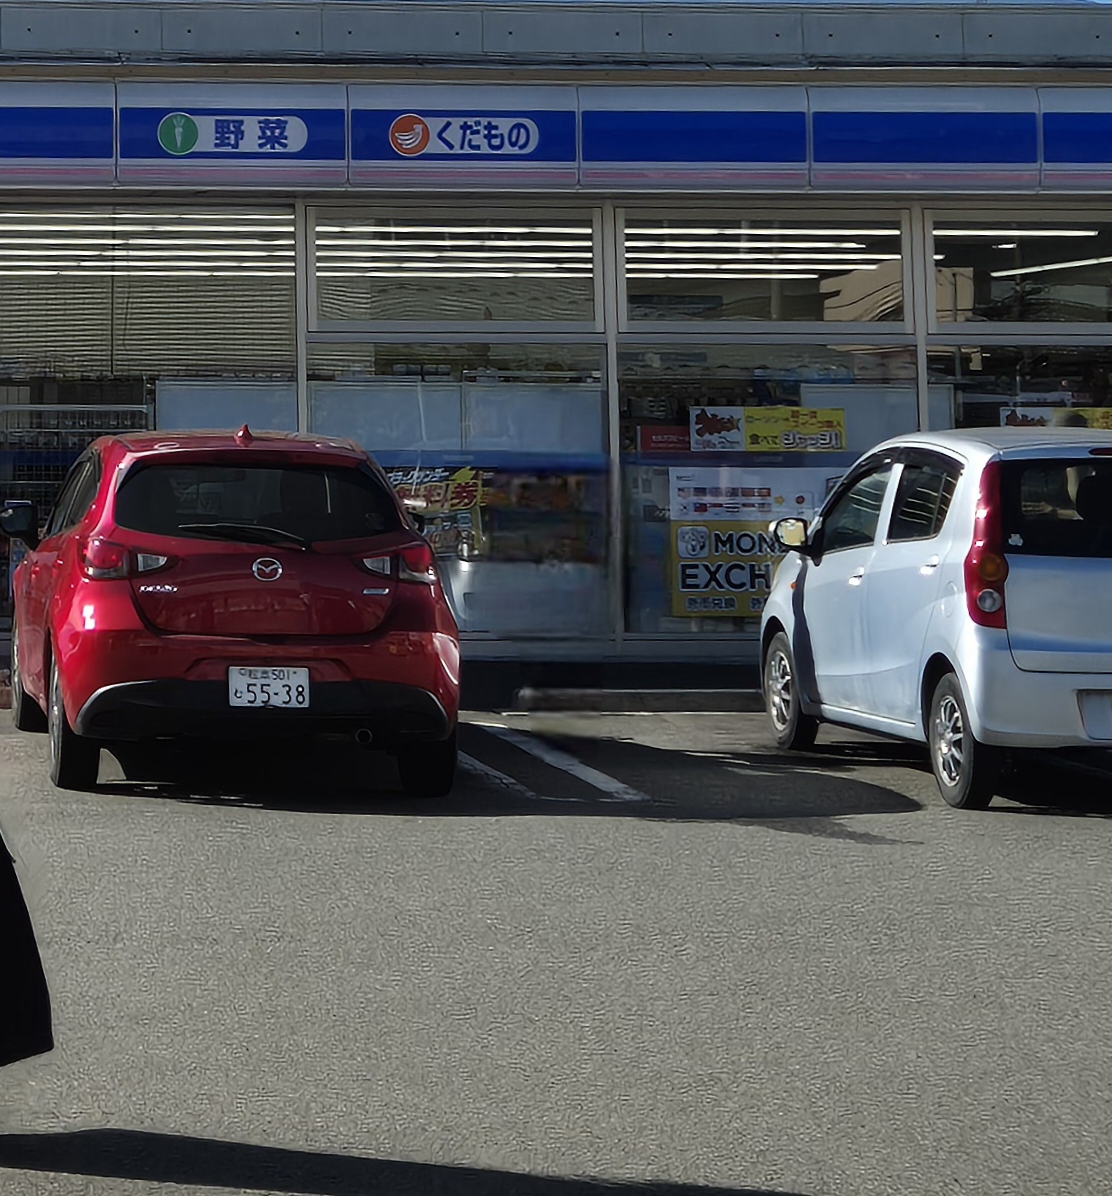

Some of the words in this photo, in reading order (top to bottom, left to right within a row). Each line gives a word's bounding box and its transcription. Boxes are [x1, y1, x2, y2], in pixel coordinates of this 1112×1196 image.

[213, 118, 289, 151] 野菜
[436, 120, 530, 152] くだもの
[713, 532, 786, 554] MON
[681, 563, 771, 590] EXCH
[246, 684, 305, 705] 55-38
